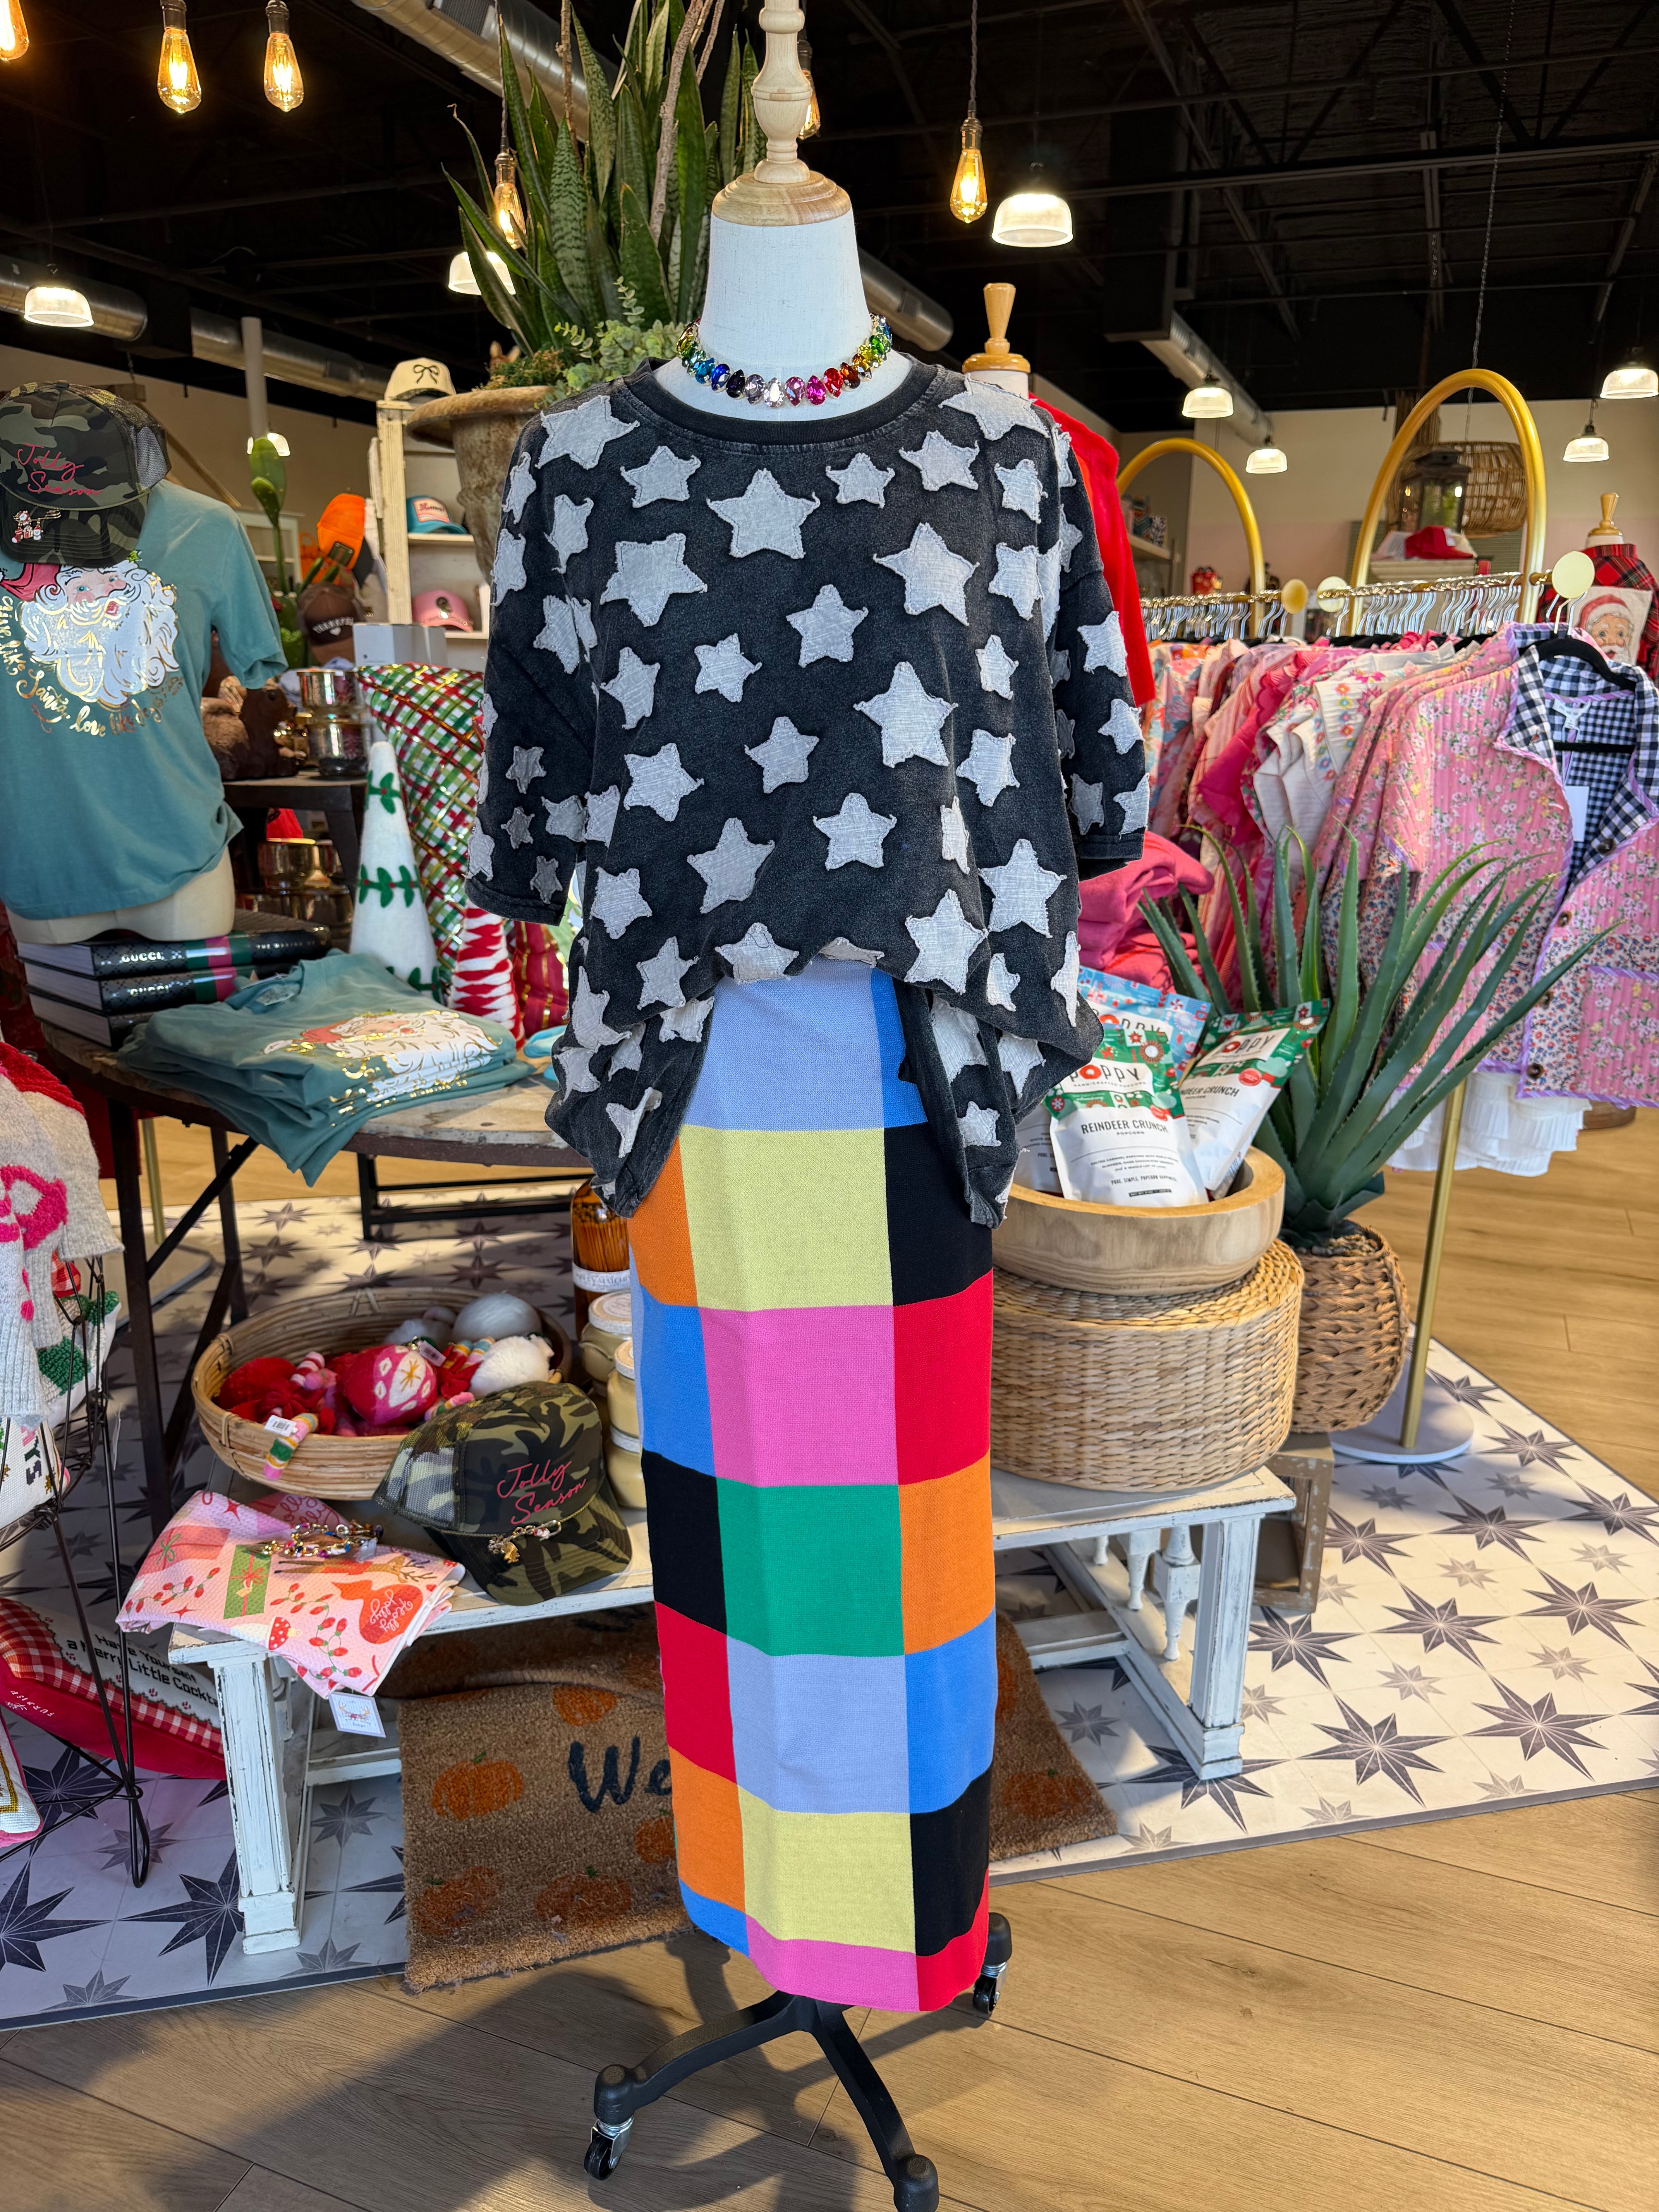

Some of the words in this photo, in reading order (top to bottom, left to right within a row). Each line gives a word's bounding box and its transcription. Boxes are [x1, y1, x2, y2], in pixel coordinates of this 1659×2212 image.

[17, 443, 84, 483] Jolly
[27, 471, 102, 496] Season
[69, 705, 106, 737] love
[121, 951, 161, 963] GUCCI
[130, 985, 169, 997] GUCCI
[1203, 1085, 1240, 1097] CRUNCH
[1081, 1120, 1130, 1134] REINDEER
[1132, 1120, 1169, 1133] CRUNCH
[497, 1459, 572, 1498] Jolly
[510, 1479, 586, 1525] Season
[67, 1640, 77, 1650] a
[128, 1658, 170, 1685] Little
